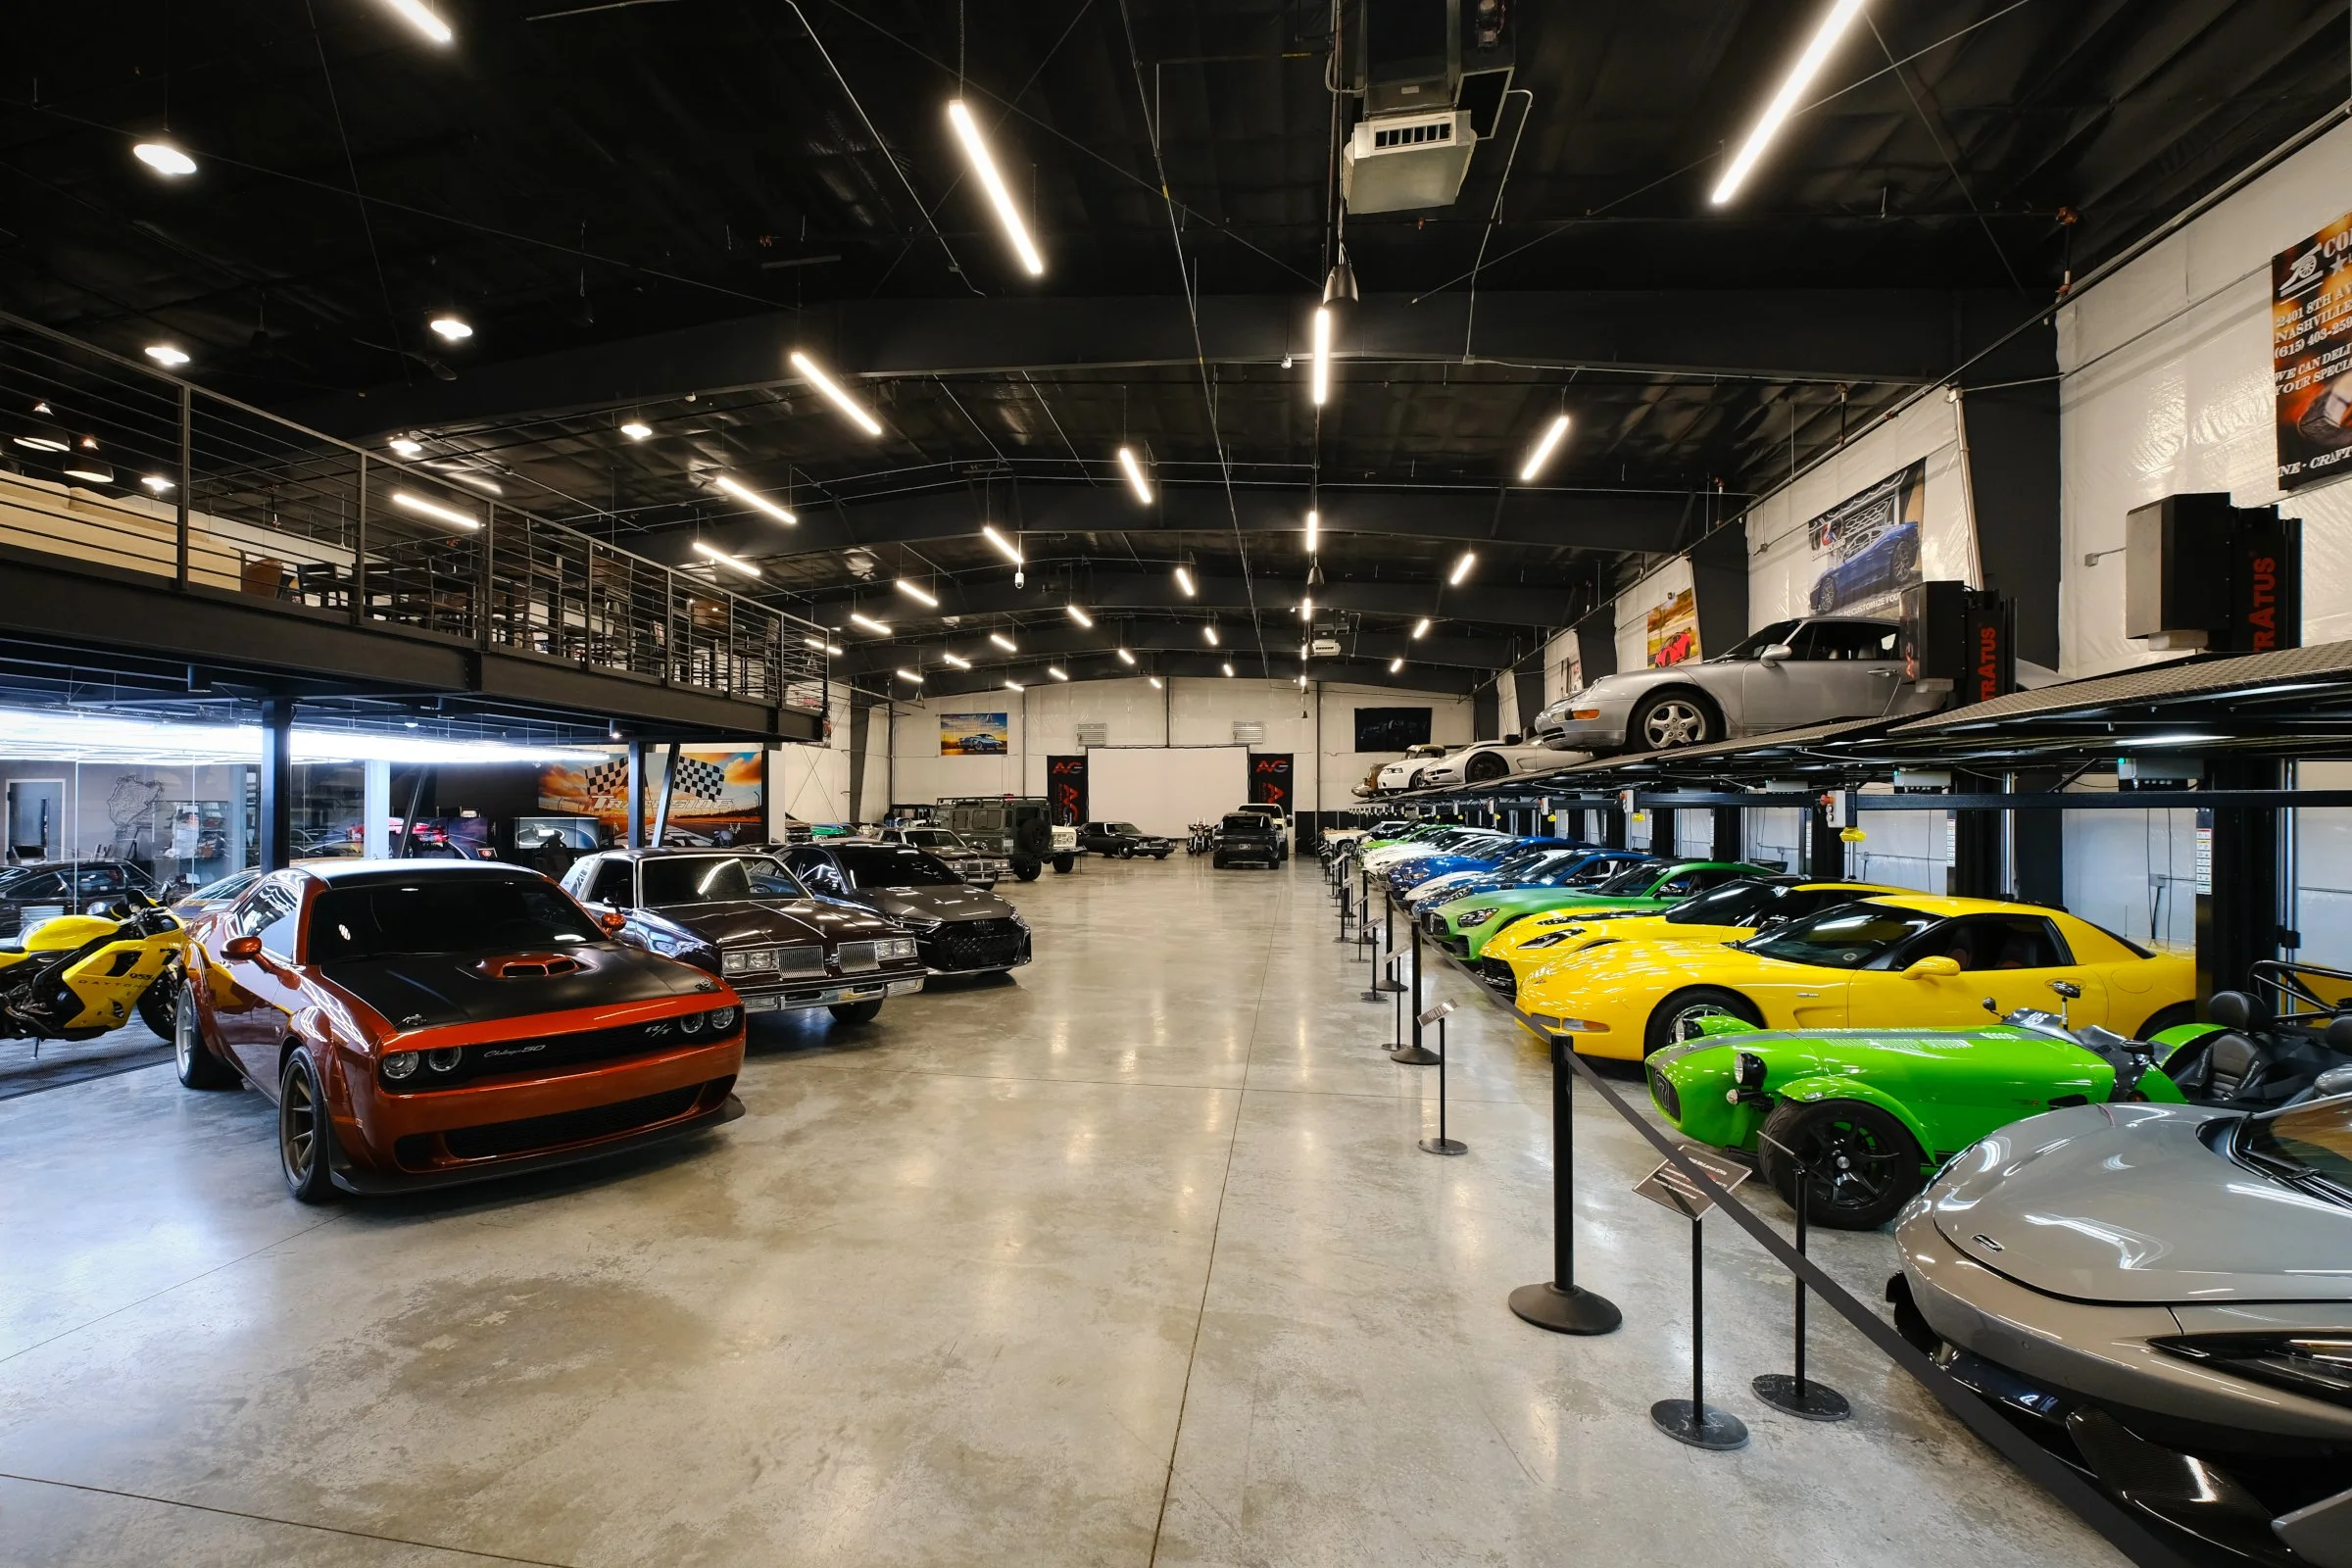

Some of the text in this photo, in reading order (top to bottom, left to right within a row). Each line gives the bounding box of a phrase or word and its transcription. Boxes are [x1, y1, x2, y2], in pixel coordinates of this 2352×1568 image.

[2277, 307, 2305, 328] 2401
[2306, 293, 2331, 315] 8TH
[2275, 338, 2305, 360] (615)
[2275, 368, 2297, 382] WE
[2297, 356, 2322, 375] CAN
[2275, 375, 2311, 396] YOUR
[645, 1023, 673, 1038] R/T
